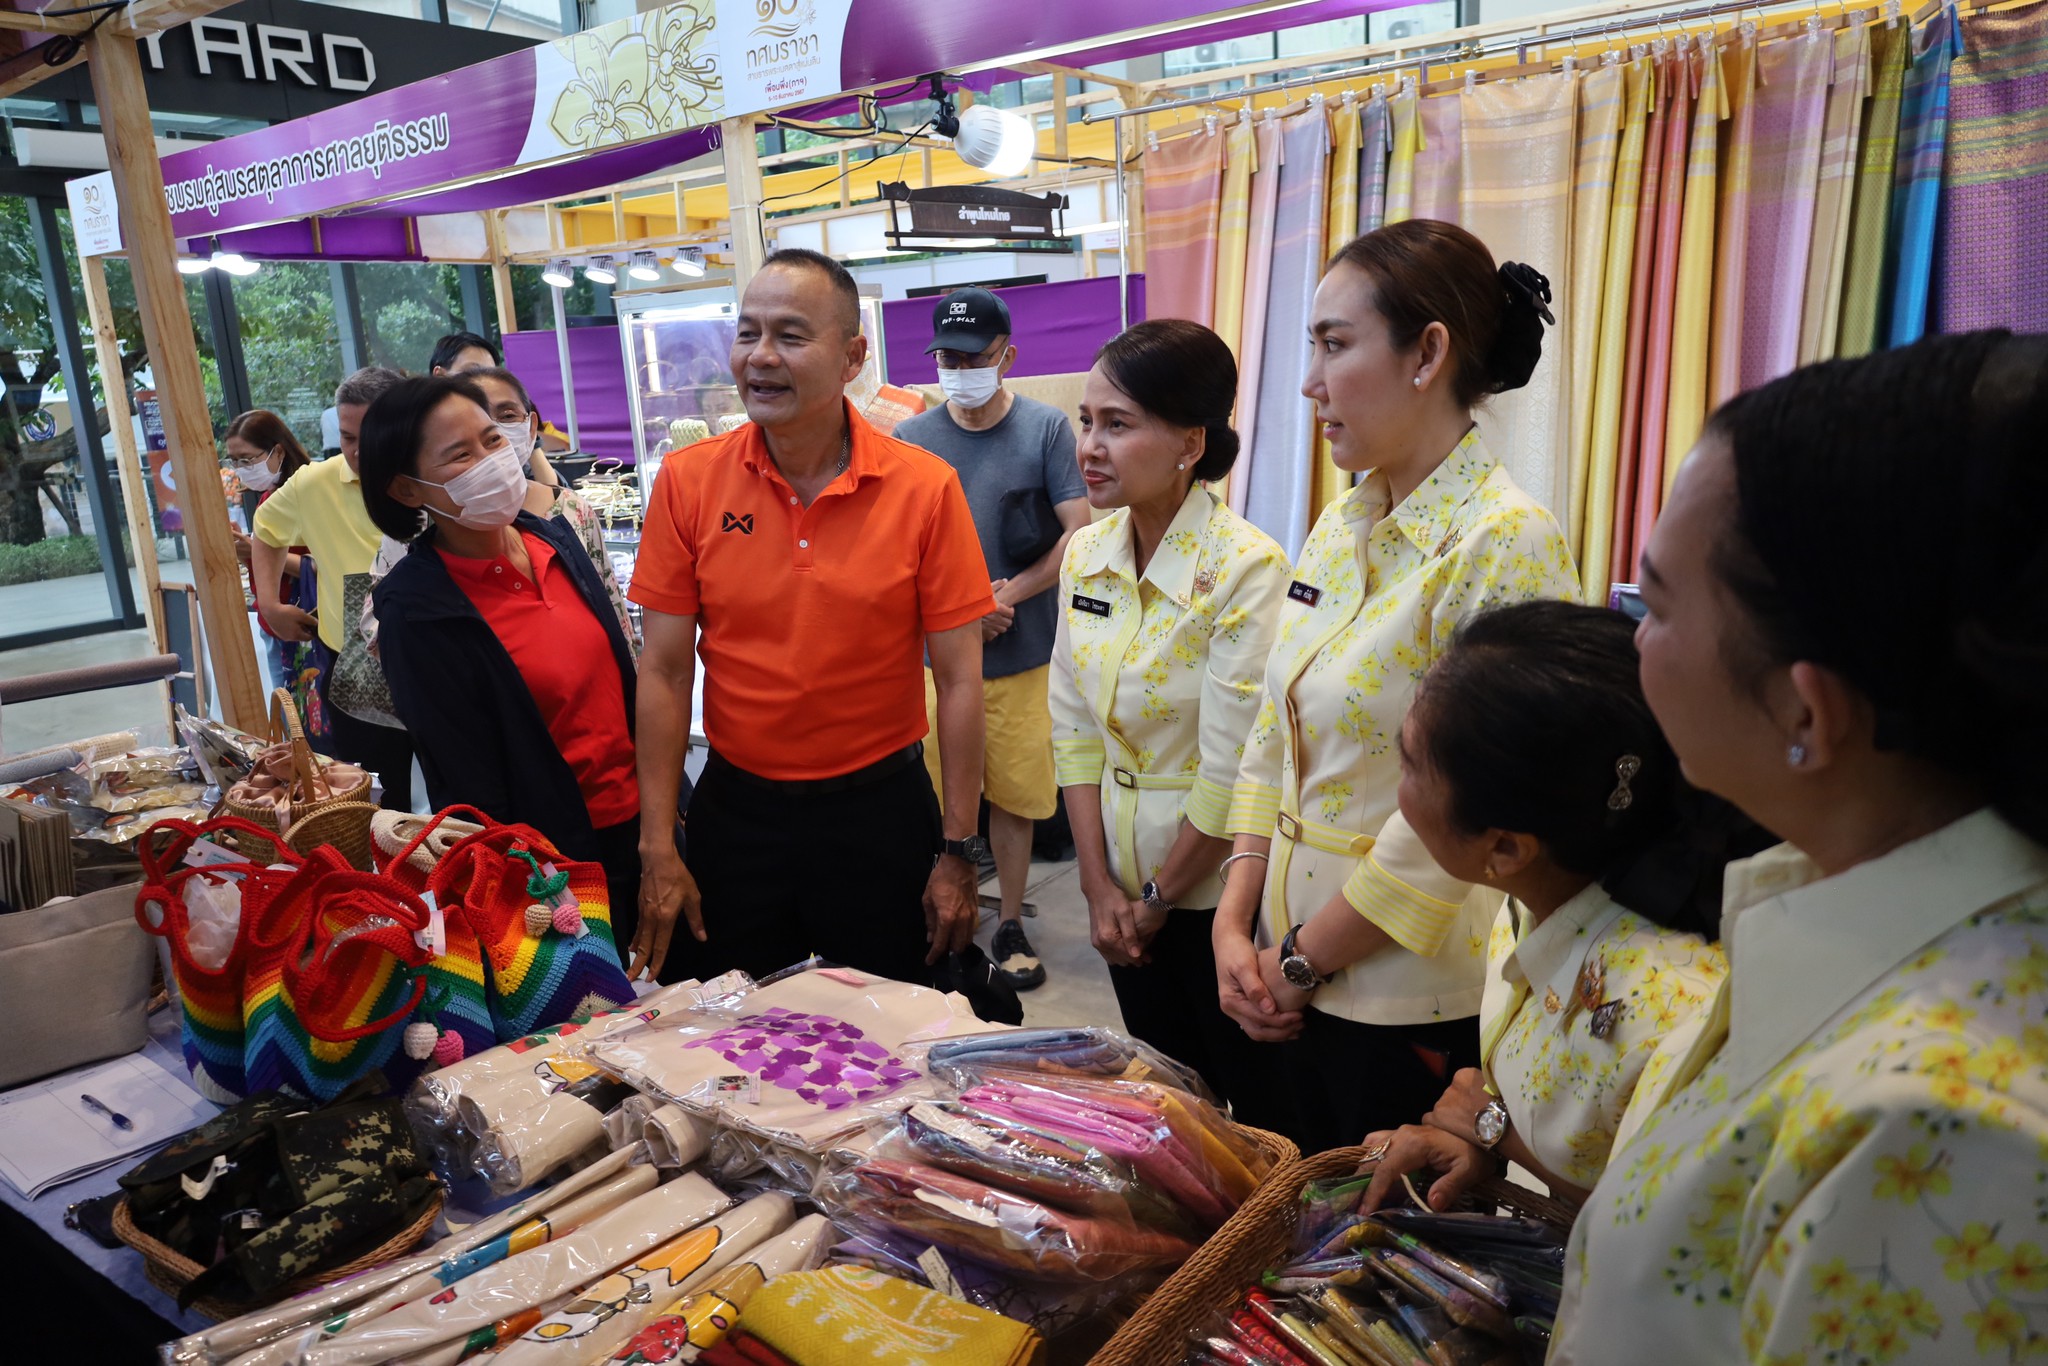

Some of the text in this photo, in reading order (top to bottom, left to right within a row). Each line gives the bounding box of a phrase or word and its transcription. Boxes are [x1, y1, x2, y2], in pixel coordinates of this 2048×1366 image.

[746, 33, 819, 69] ทศมราชา
[163, 113, 449, 216] ชมรมคู่สมรสตุลาการศาลยุติธรรม
[958, 205, 1011, 225] ลำพูนไหมไทย
